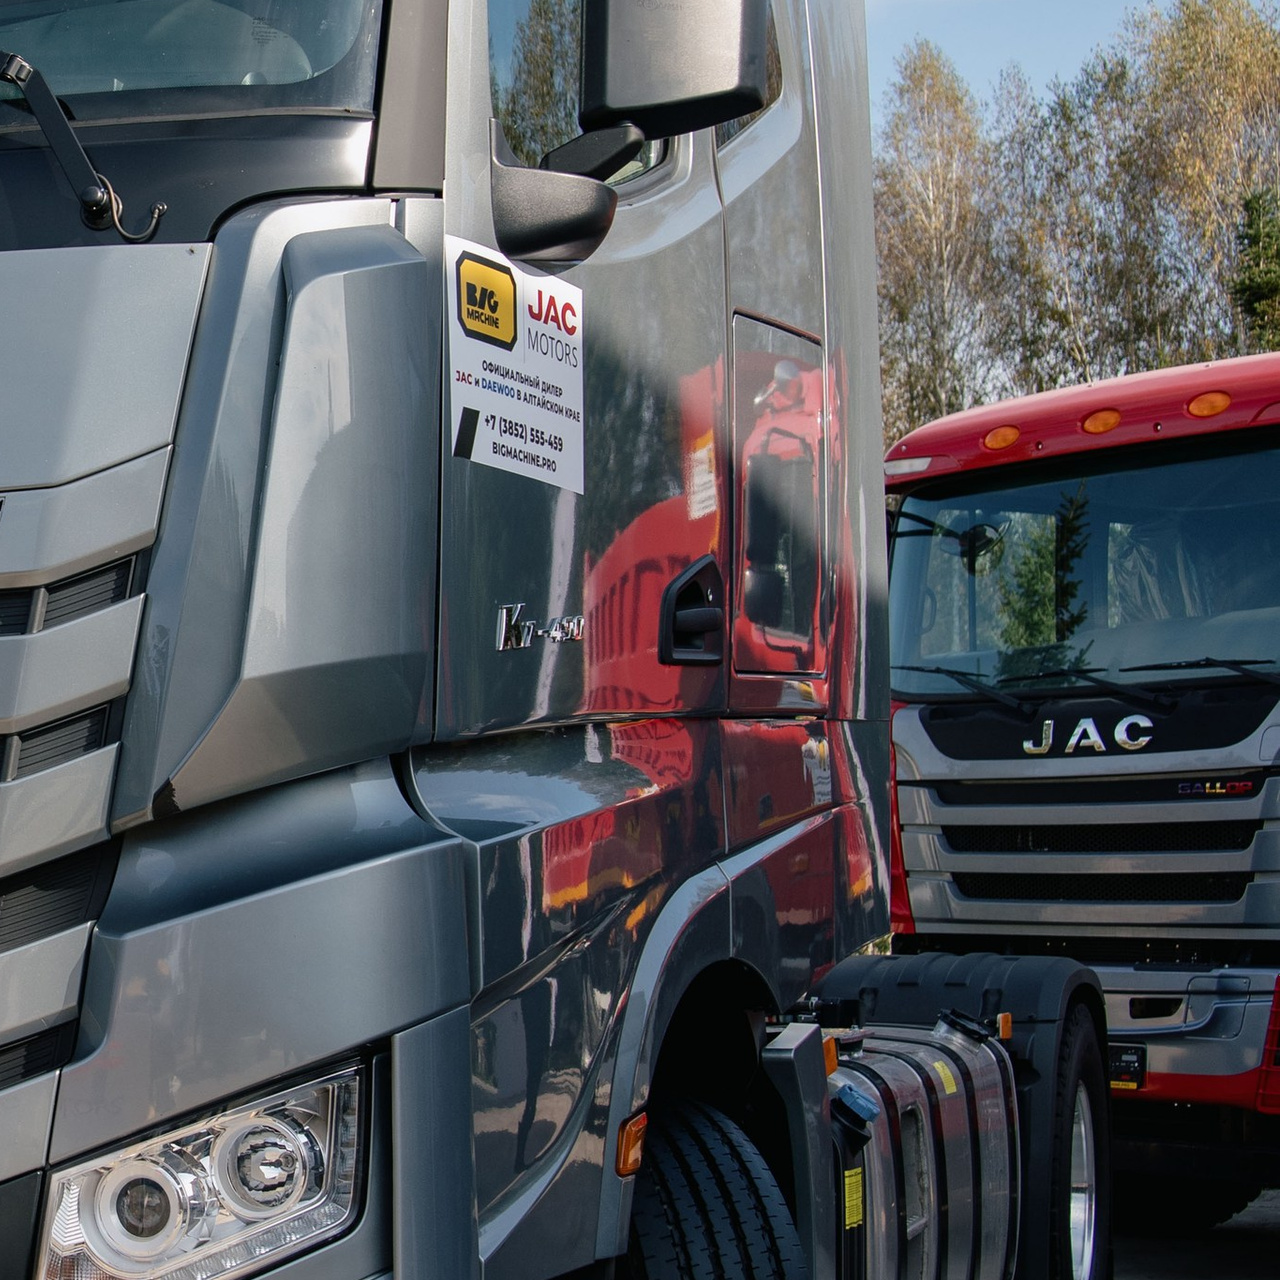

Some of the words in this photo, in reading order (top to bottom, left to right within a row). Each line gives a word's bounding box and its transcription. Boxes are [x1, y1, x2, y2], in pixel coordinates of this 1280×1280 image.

[466, 282, 499, 314] BIG
[528, 289, 577, 336] JAC
[466, 308, 499, 329] MACHINE
[528, 327, 578, 368] MOTORS
[456, 370, 472, 385] JAC
[481, 378, 515, 399] DAEWOO
[523, 391, 564, 417] АЛТАЙСКОМ
[565, 407, 580, 422] КРАЕ
[482, 360, 540, 390] ОФИЦИАЛЬНЫЙ
[541, 381, 563, 398] ДИЛЕР
[484, 414, 496, 430] +7
[499, 416, 527, 444] (3852)
[530, 427, 563, 452] 555-459
[492, 441, 557, 472] BIGMACHINE.PRO
[1022, 714, 1154, 755] JAC
[1178, 781, 1253, 794] GALLOP
